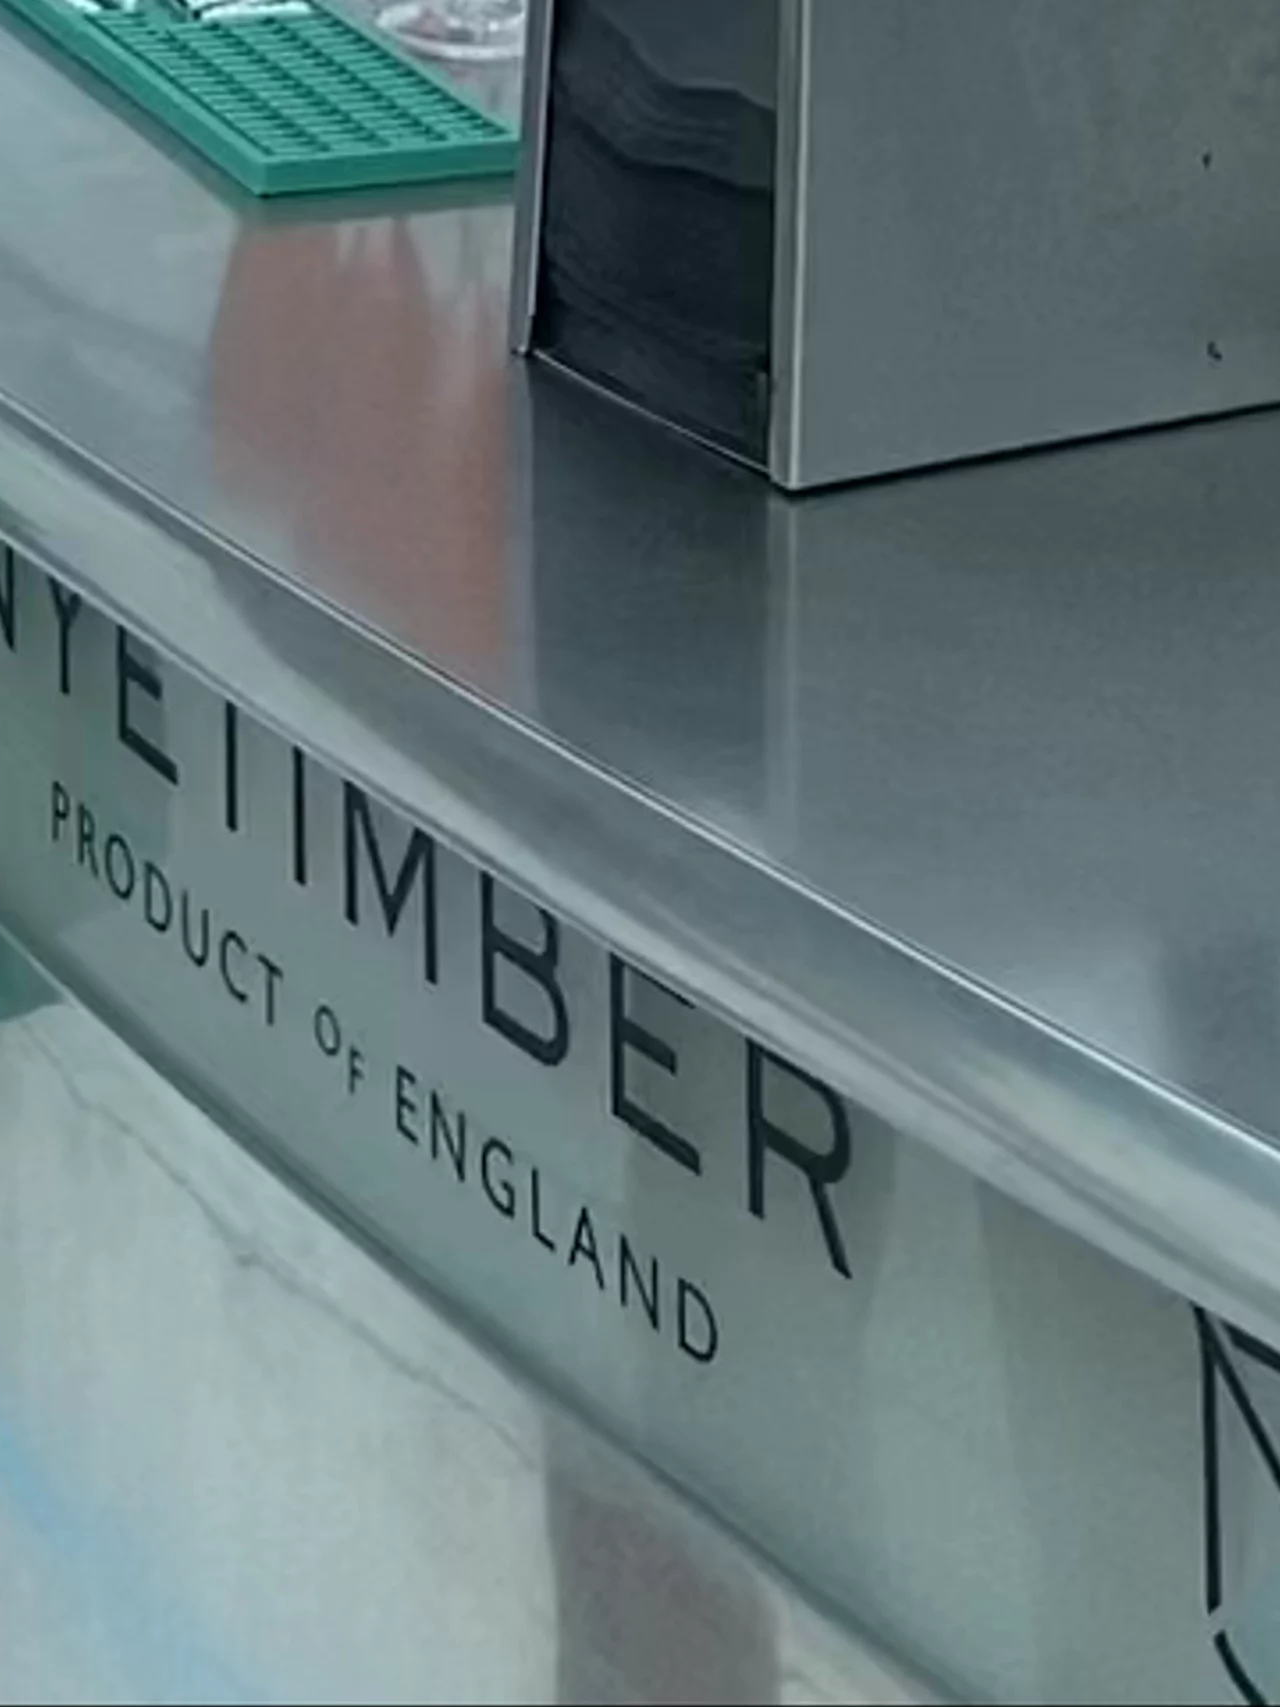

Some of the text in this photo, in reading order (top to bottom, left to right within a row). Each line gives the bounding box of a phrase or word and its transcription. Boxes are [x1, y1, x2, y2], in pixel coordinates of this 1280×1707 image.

[51, 780, 719, 1364] PRODUCT OF ENGLAND
